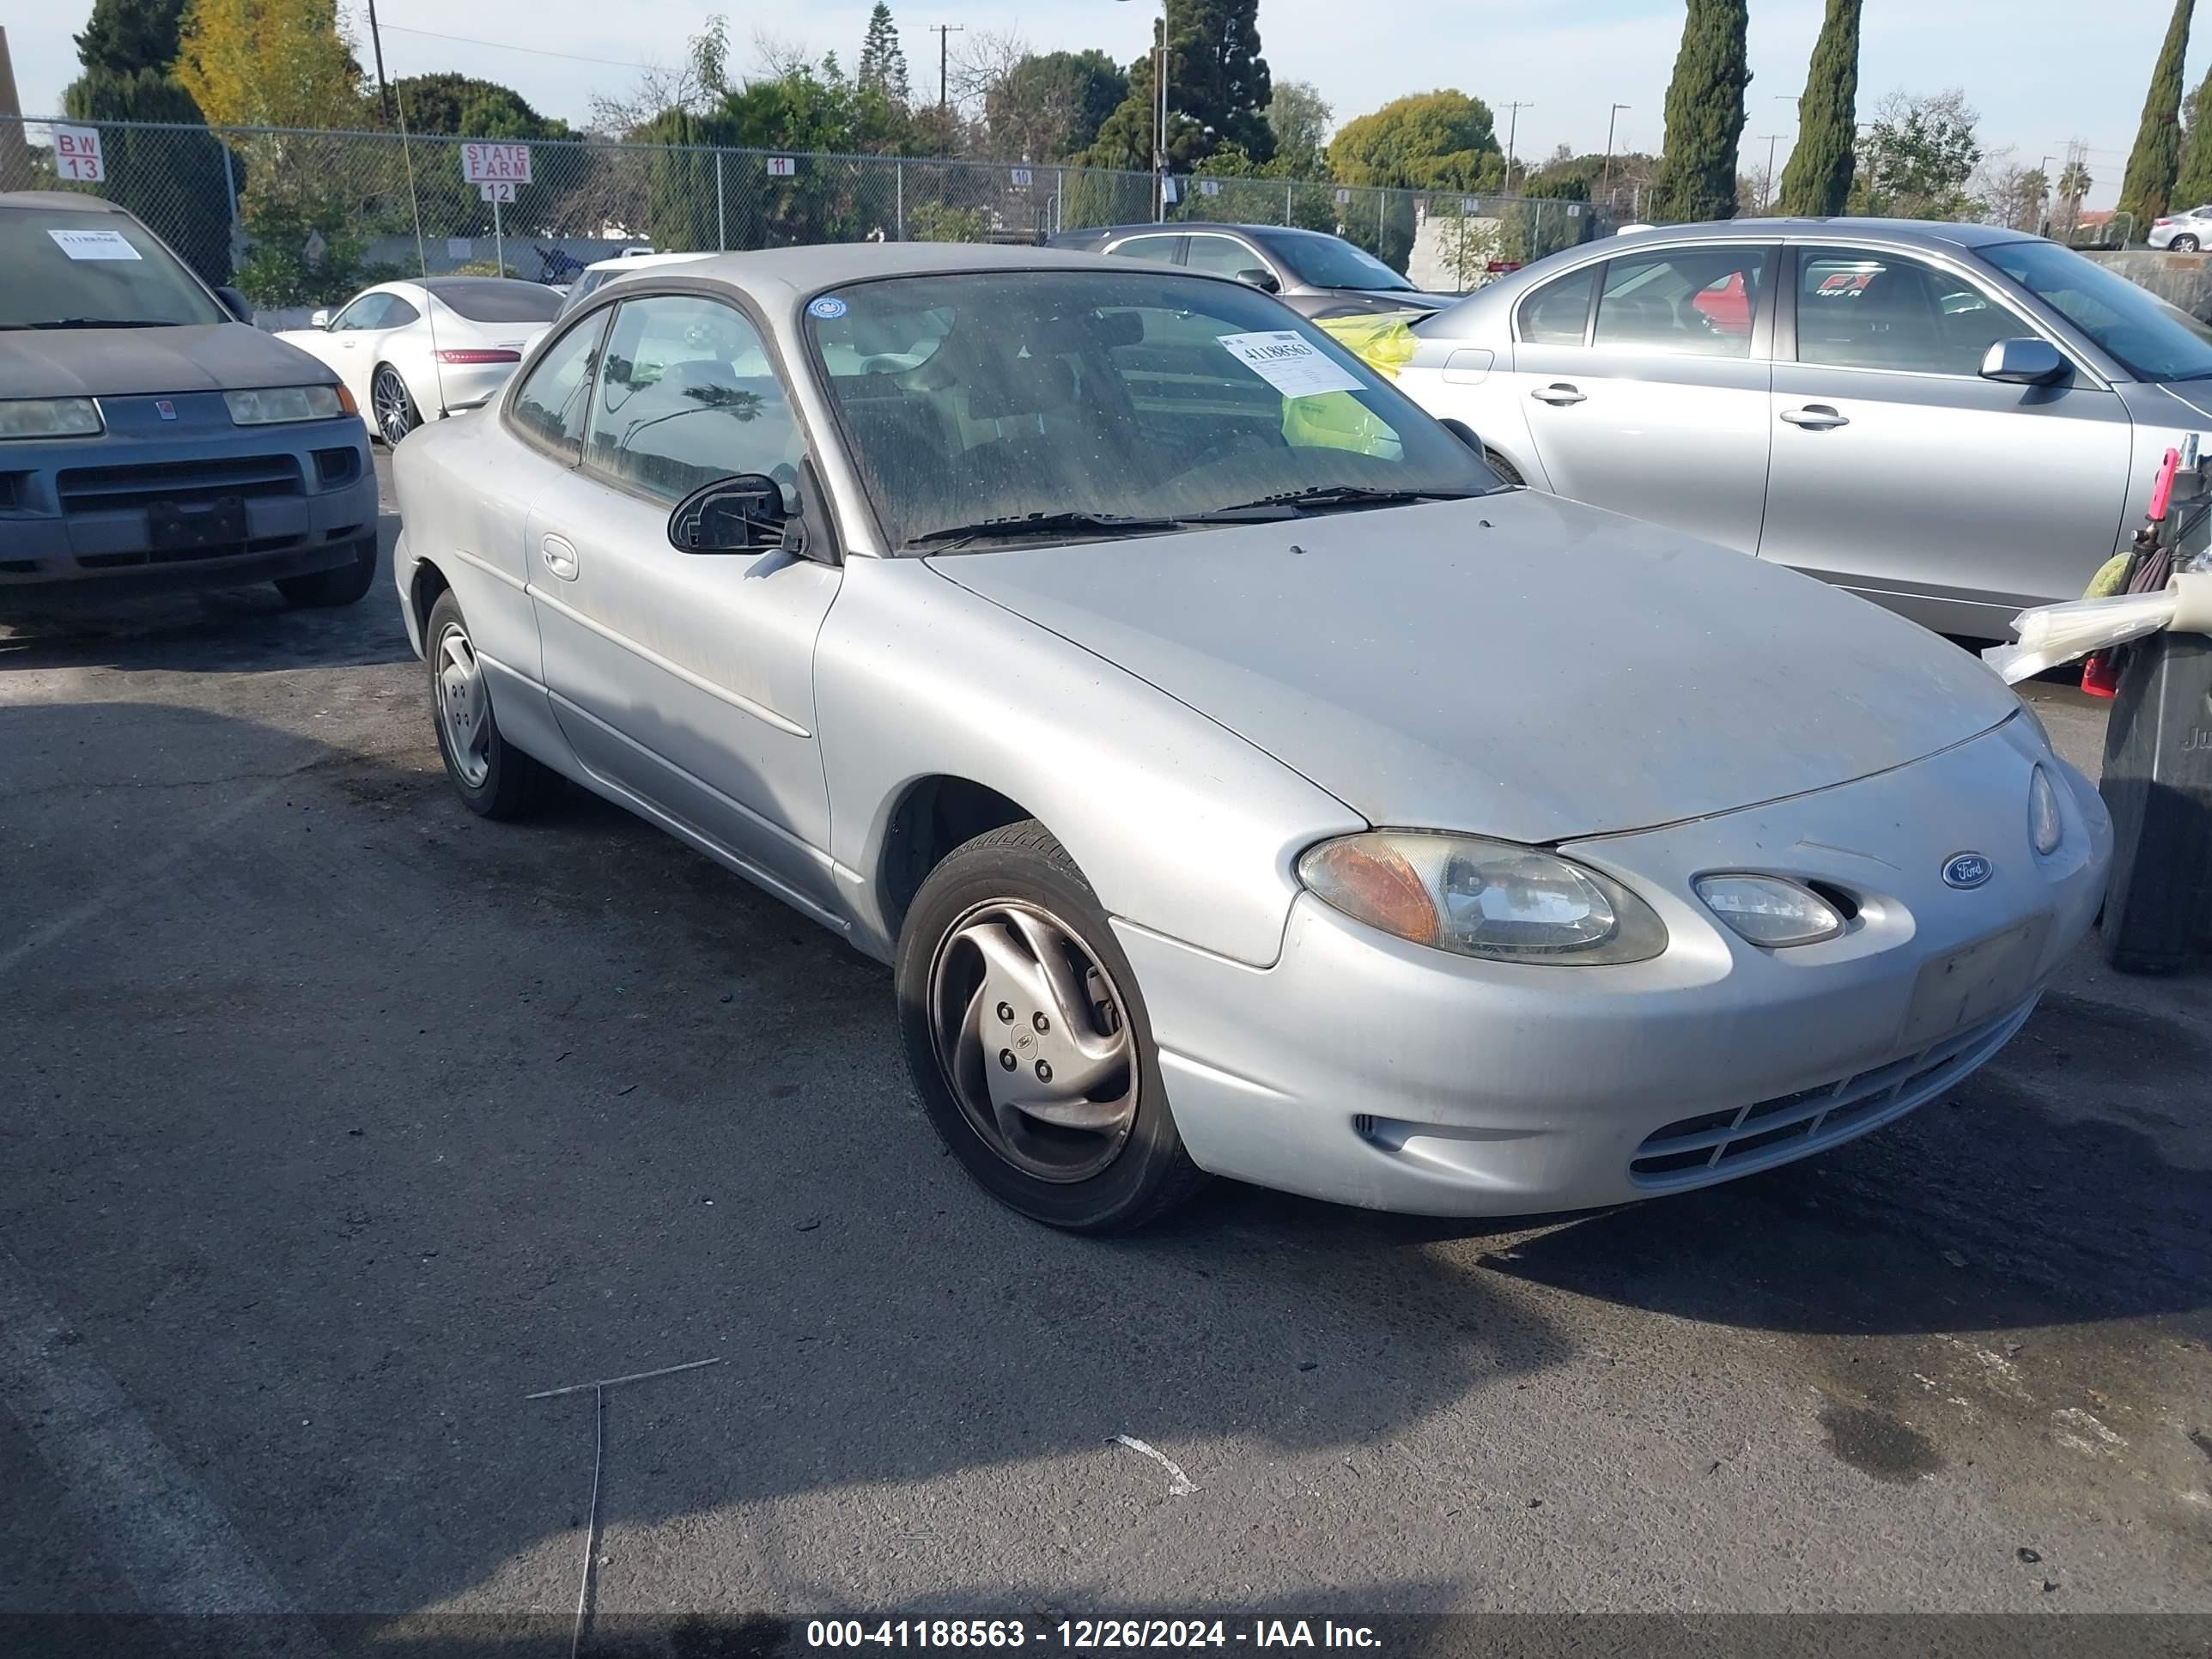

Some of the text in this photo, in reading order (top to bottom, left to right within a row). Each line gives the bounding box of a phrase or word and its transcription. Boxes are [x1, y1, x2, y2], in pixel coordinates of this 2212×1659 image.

[58, 134, 94, 154] BW
[467, 145, 527, 161] STATE
[69, 159, 98, 179] 13
[471, 161, 526, 177] FARM
[775, 157, 785, 173] 11
[1016, 171, 1029, 184] 10
[488, 183, 509, 200] 12
[1244, 343, 1313, 361] 41188563
[1956, 860, 1984, 880] Ford
